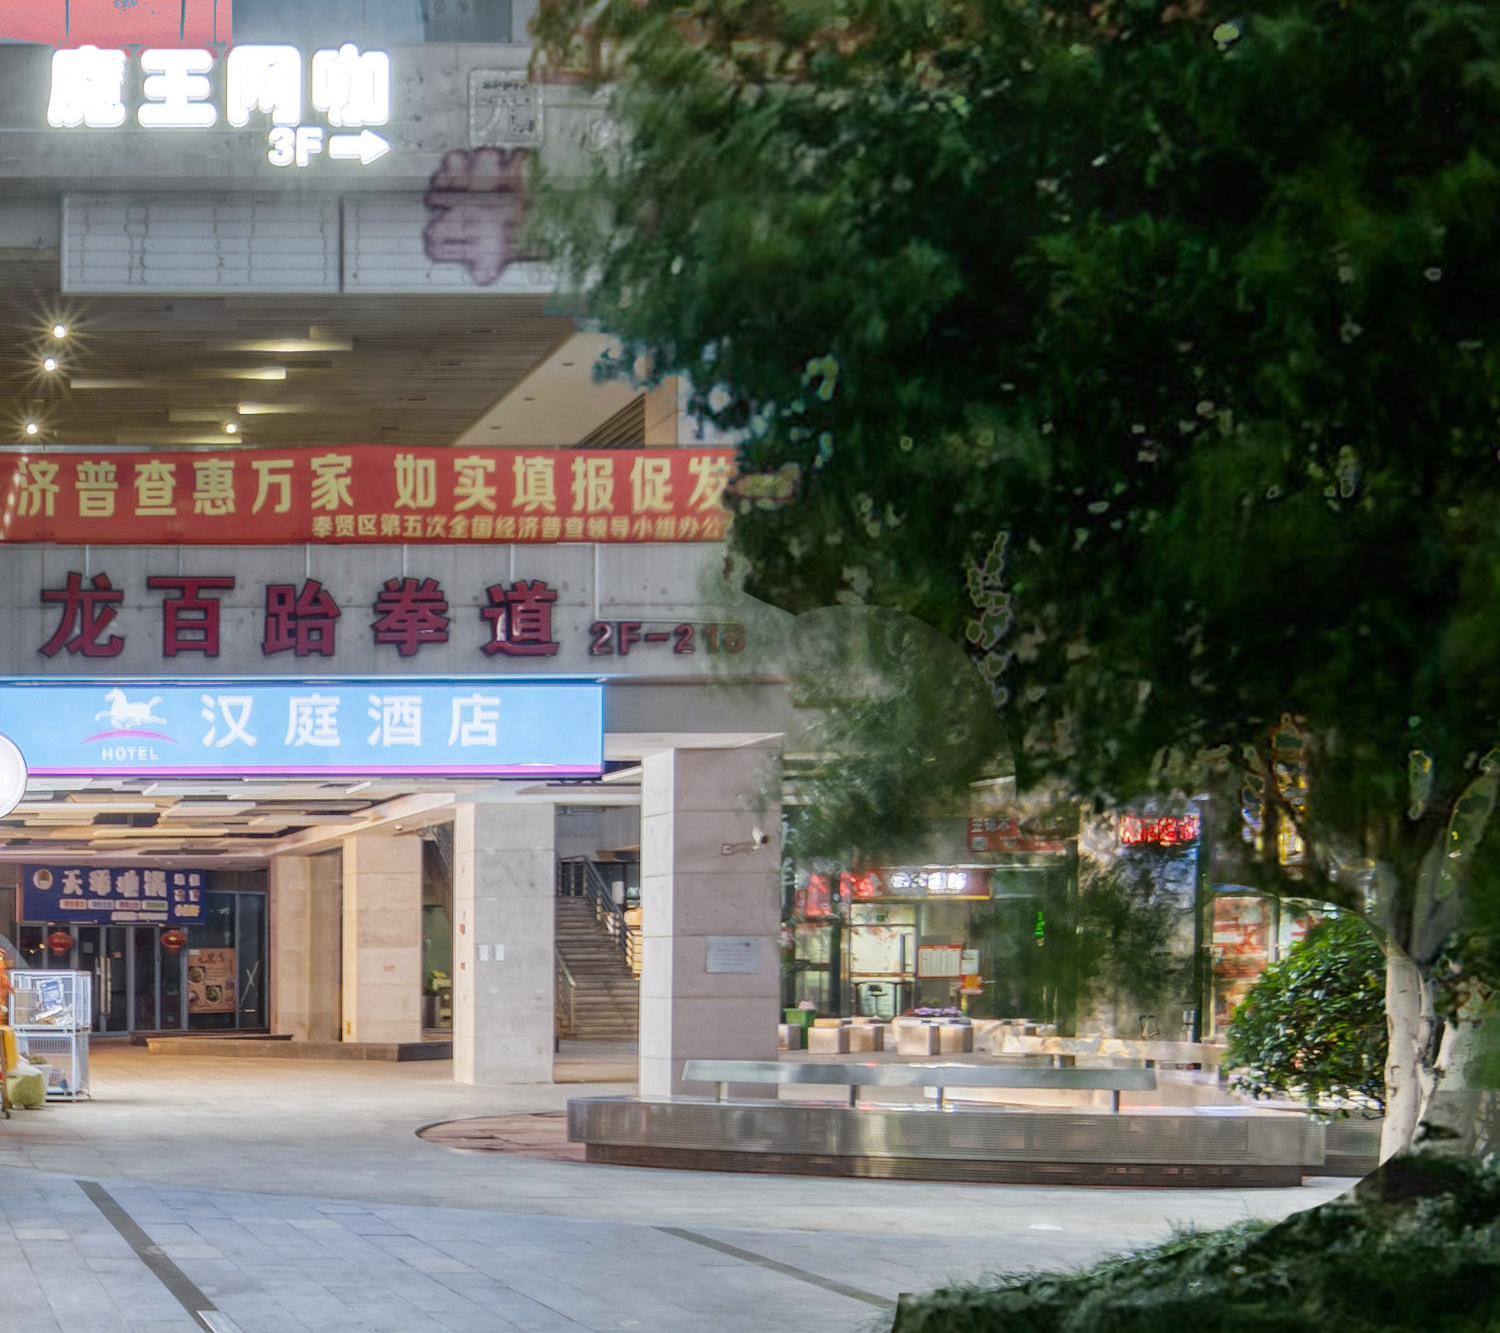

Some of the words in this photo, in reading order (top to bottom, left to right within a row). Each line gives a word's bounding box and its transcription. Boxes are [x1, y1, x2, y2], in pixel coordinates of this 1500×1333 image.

[267, 127, 324, 167] 3F
[394, 454, 731, 513] 如实填报促发
[39, 572, 560, 658] 龙百跆拳道
[588, 620, 748, 656] 2F-216
[199, 691, 502, 748] 汉庭酒店
[101, 746, 159, 761] HOTEL
